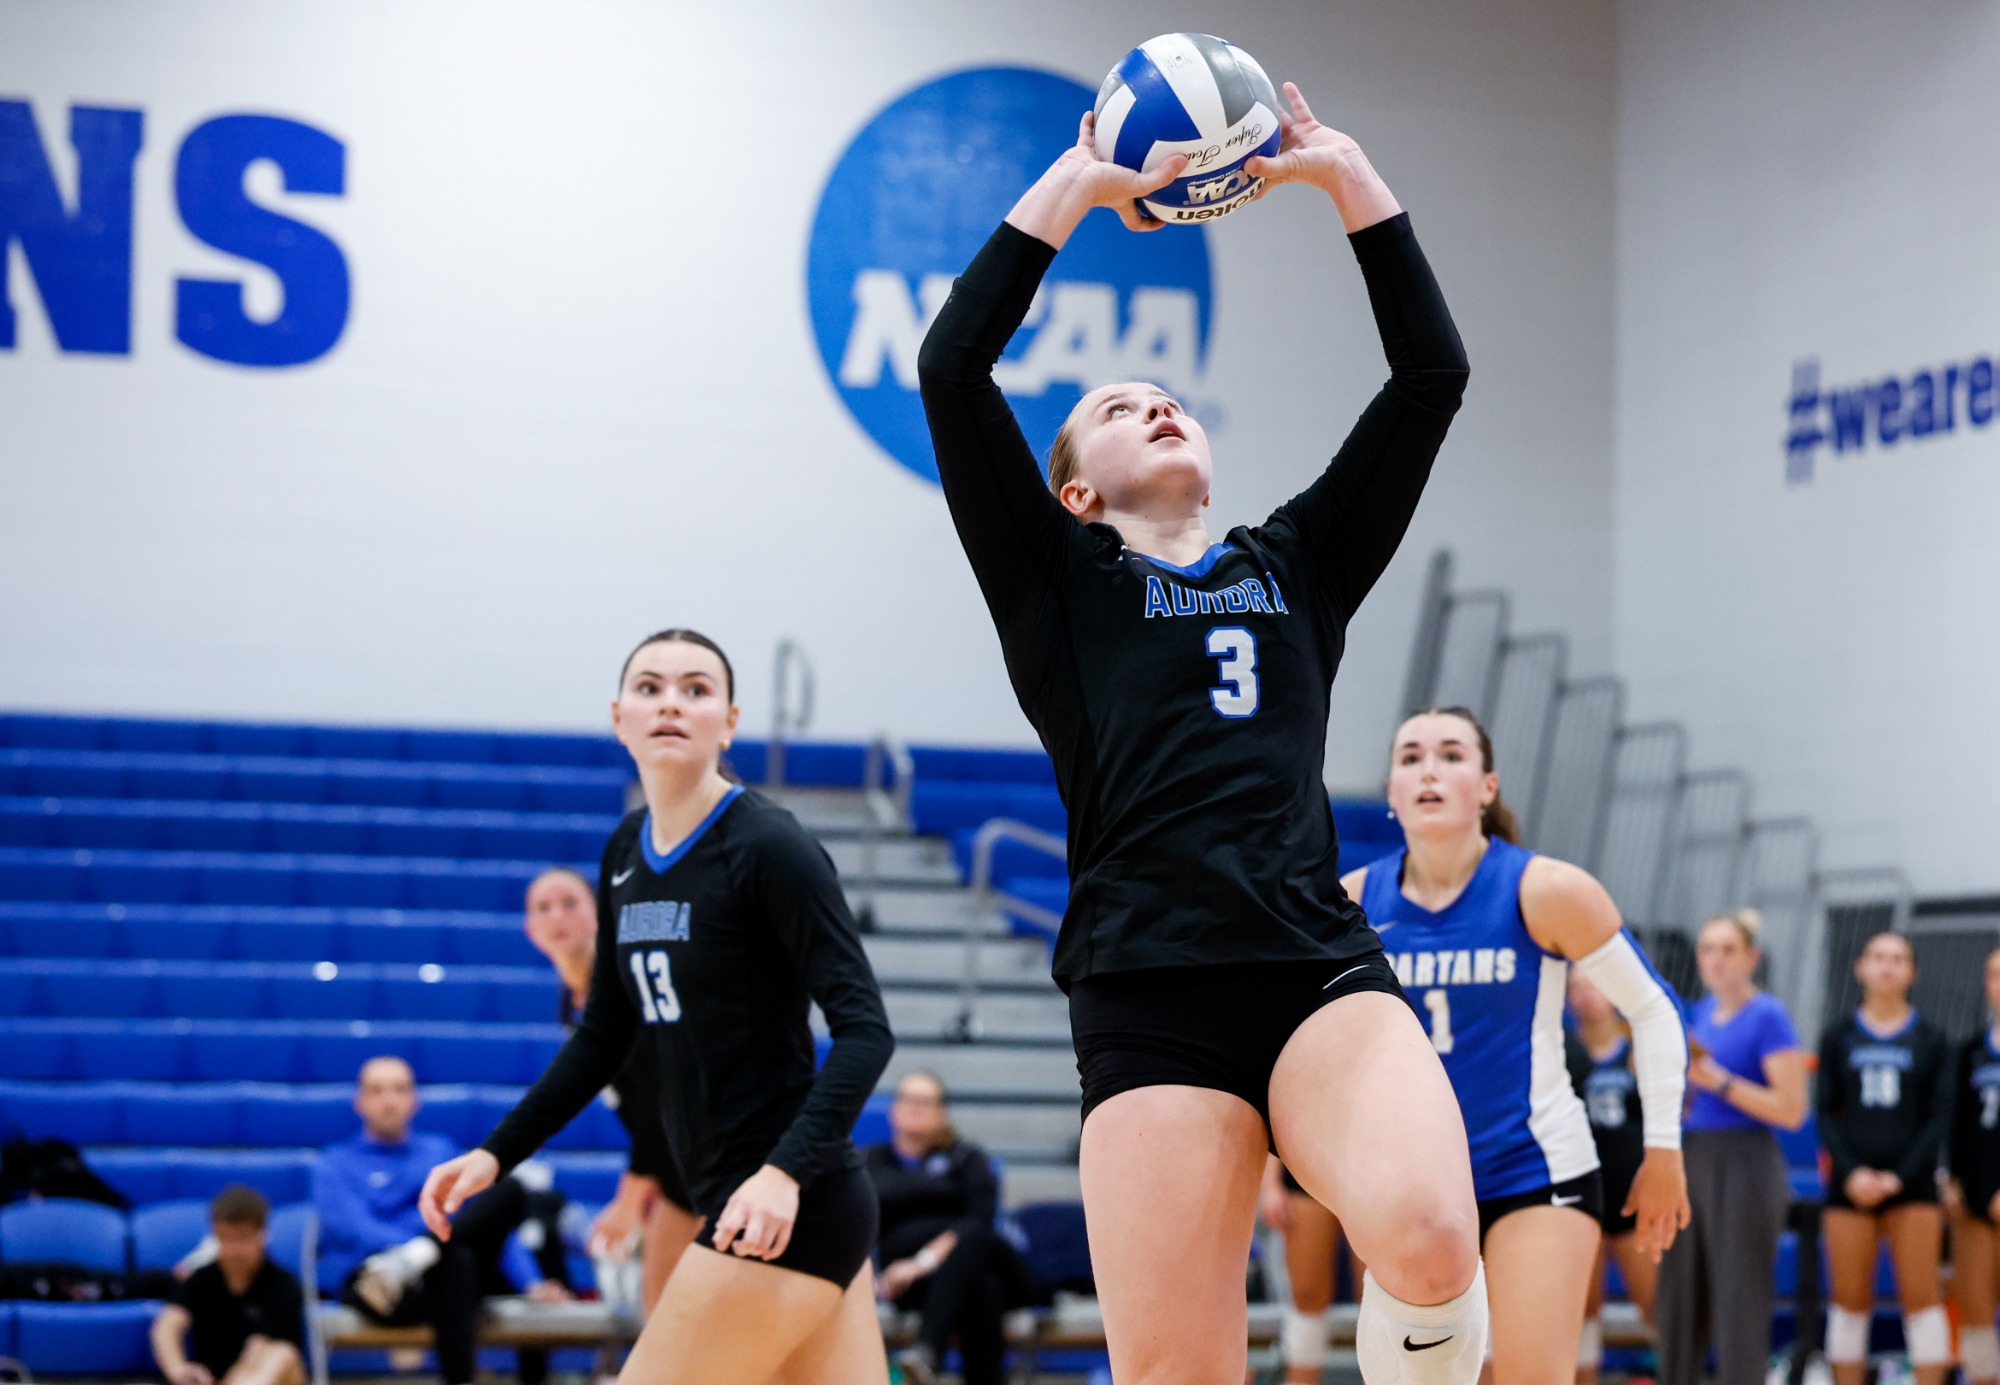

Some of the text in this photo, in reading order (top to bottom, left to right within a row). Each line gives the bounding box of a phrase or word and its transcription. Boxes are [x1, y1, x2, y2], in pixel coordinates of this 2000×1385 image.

[1184, 124, 1262, 168] Super Tou
[1204, 625, 1260, 719] 3
[630, 949, 683, 1025] 13
[1423, 988, 1454, 1054] 1
